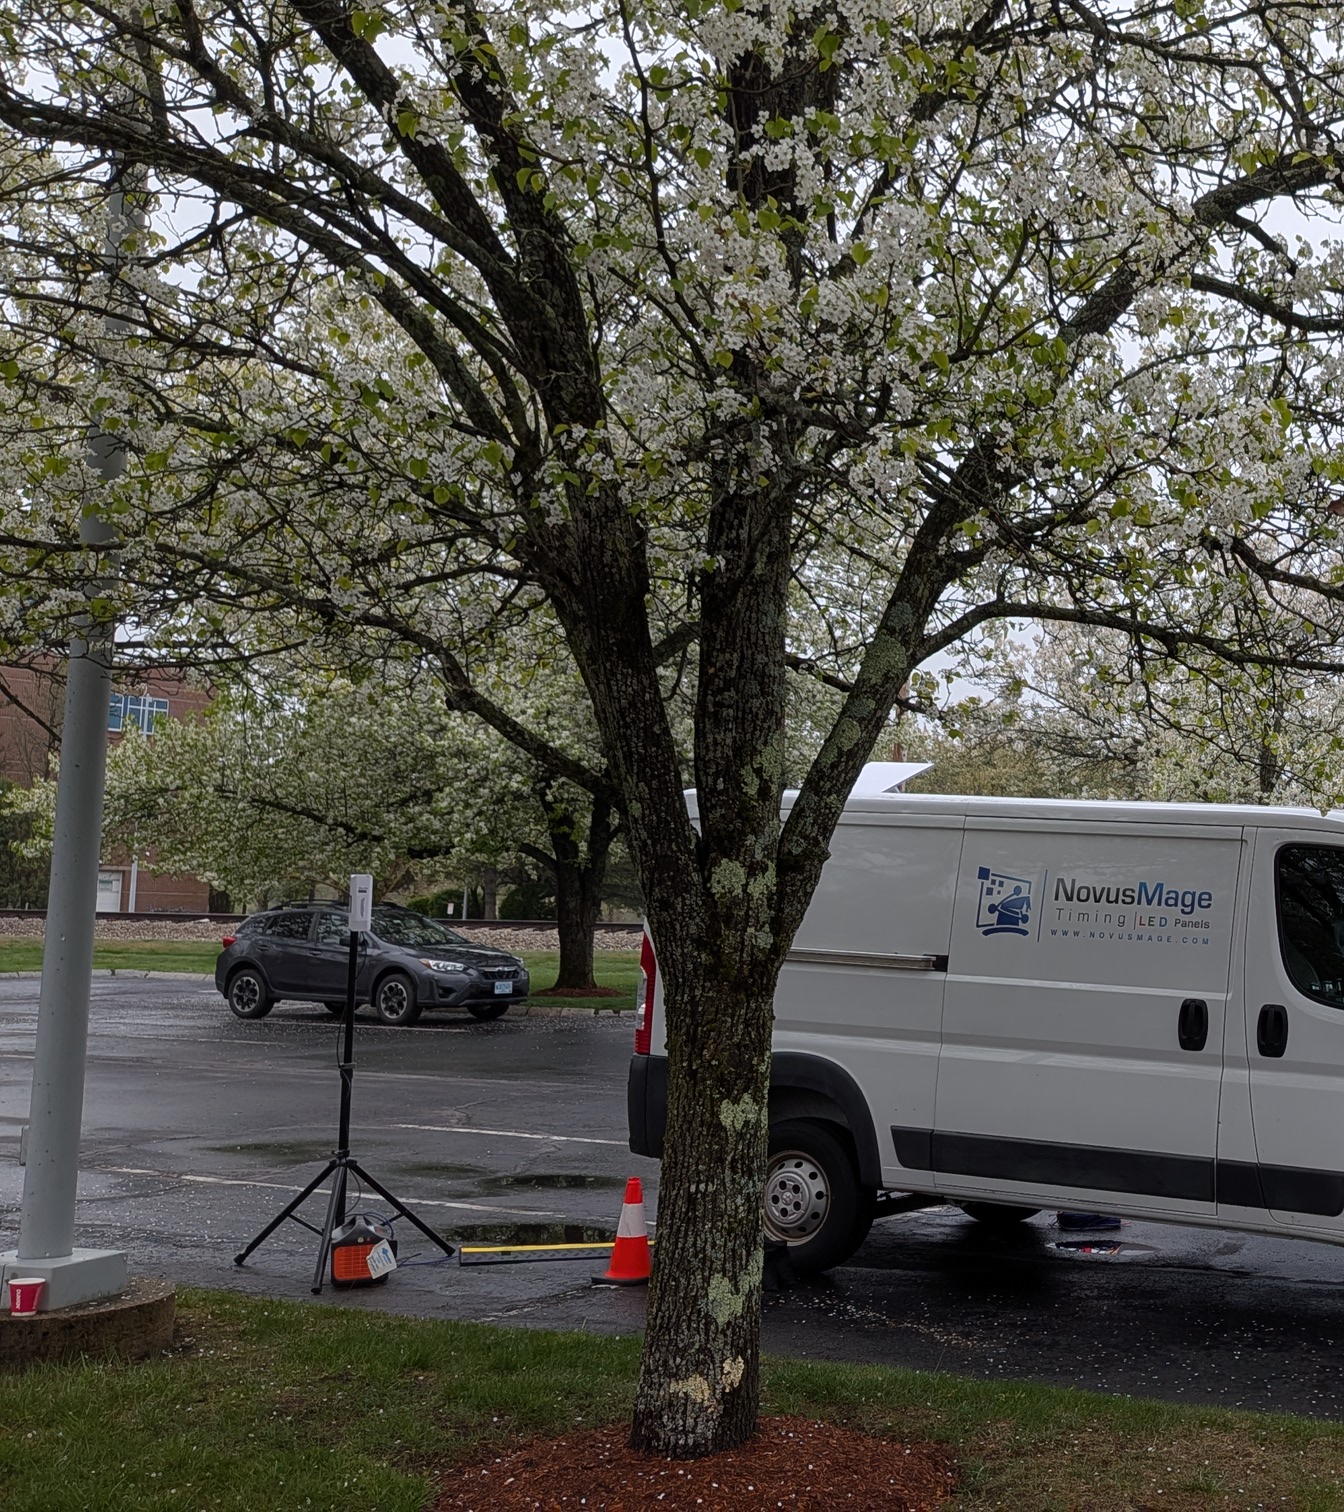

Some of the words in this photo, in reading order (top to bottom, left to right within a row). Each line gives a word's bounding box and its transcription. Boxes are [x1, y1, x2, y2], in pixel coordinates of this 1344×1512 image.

[1054, 877, 1213, 915] NovusMage
[1055, 908, 1126, 927] Timing
[1139, 916, 1168, 927] LED
[1173, 918, 1210, 929] Panels
[1050, 929, 1210, 945] WWW.NOVUSMAGE.COM
